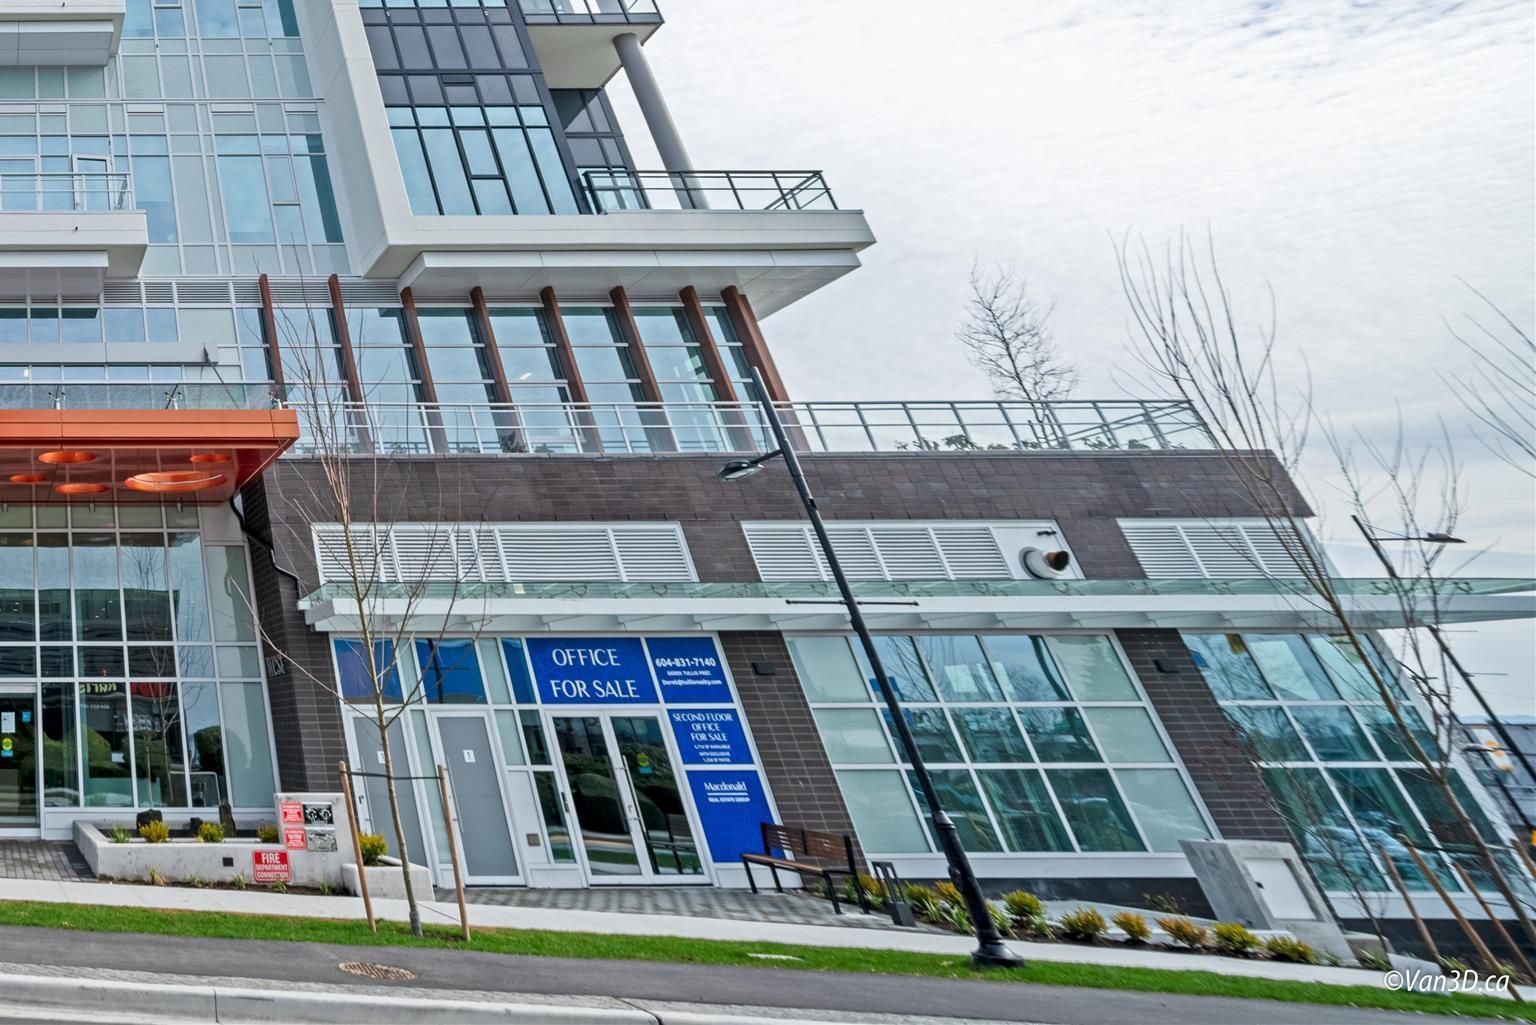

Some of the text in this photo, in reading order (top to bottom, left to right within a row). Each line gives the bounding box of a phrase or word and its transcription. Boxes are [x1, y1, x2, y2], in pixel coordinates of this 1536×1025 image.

[551, 648, 621, 667] OFFICE
[655, 657, 716, 668] 604-831-7140
[550, 679, 640, 698] FOR SALE
[672, 712, 734, 722] SECOND FLOOR
[691, 723, 720, 732] OFFICE
[690, 732, 728, 742] FOR SALE
[704, 781, 747, 791] Macdonald
[261, 852, 280, 864] FIRE
